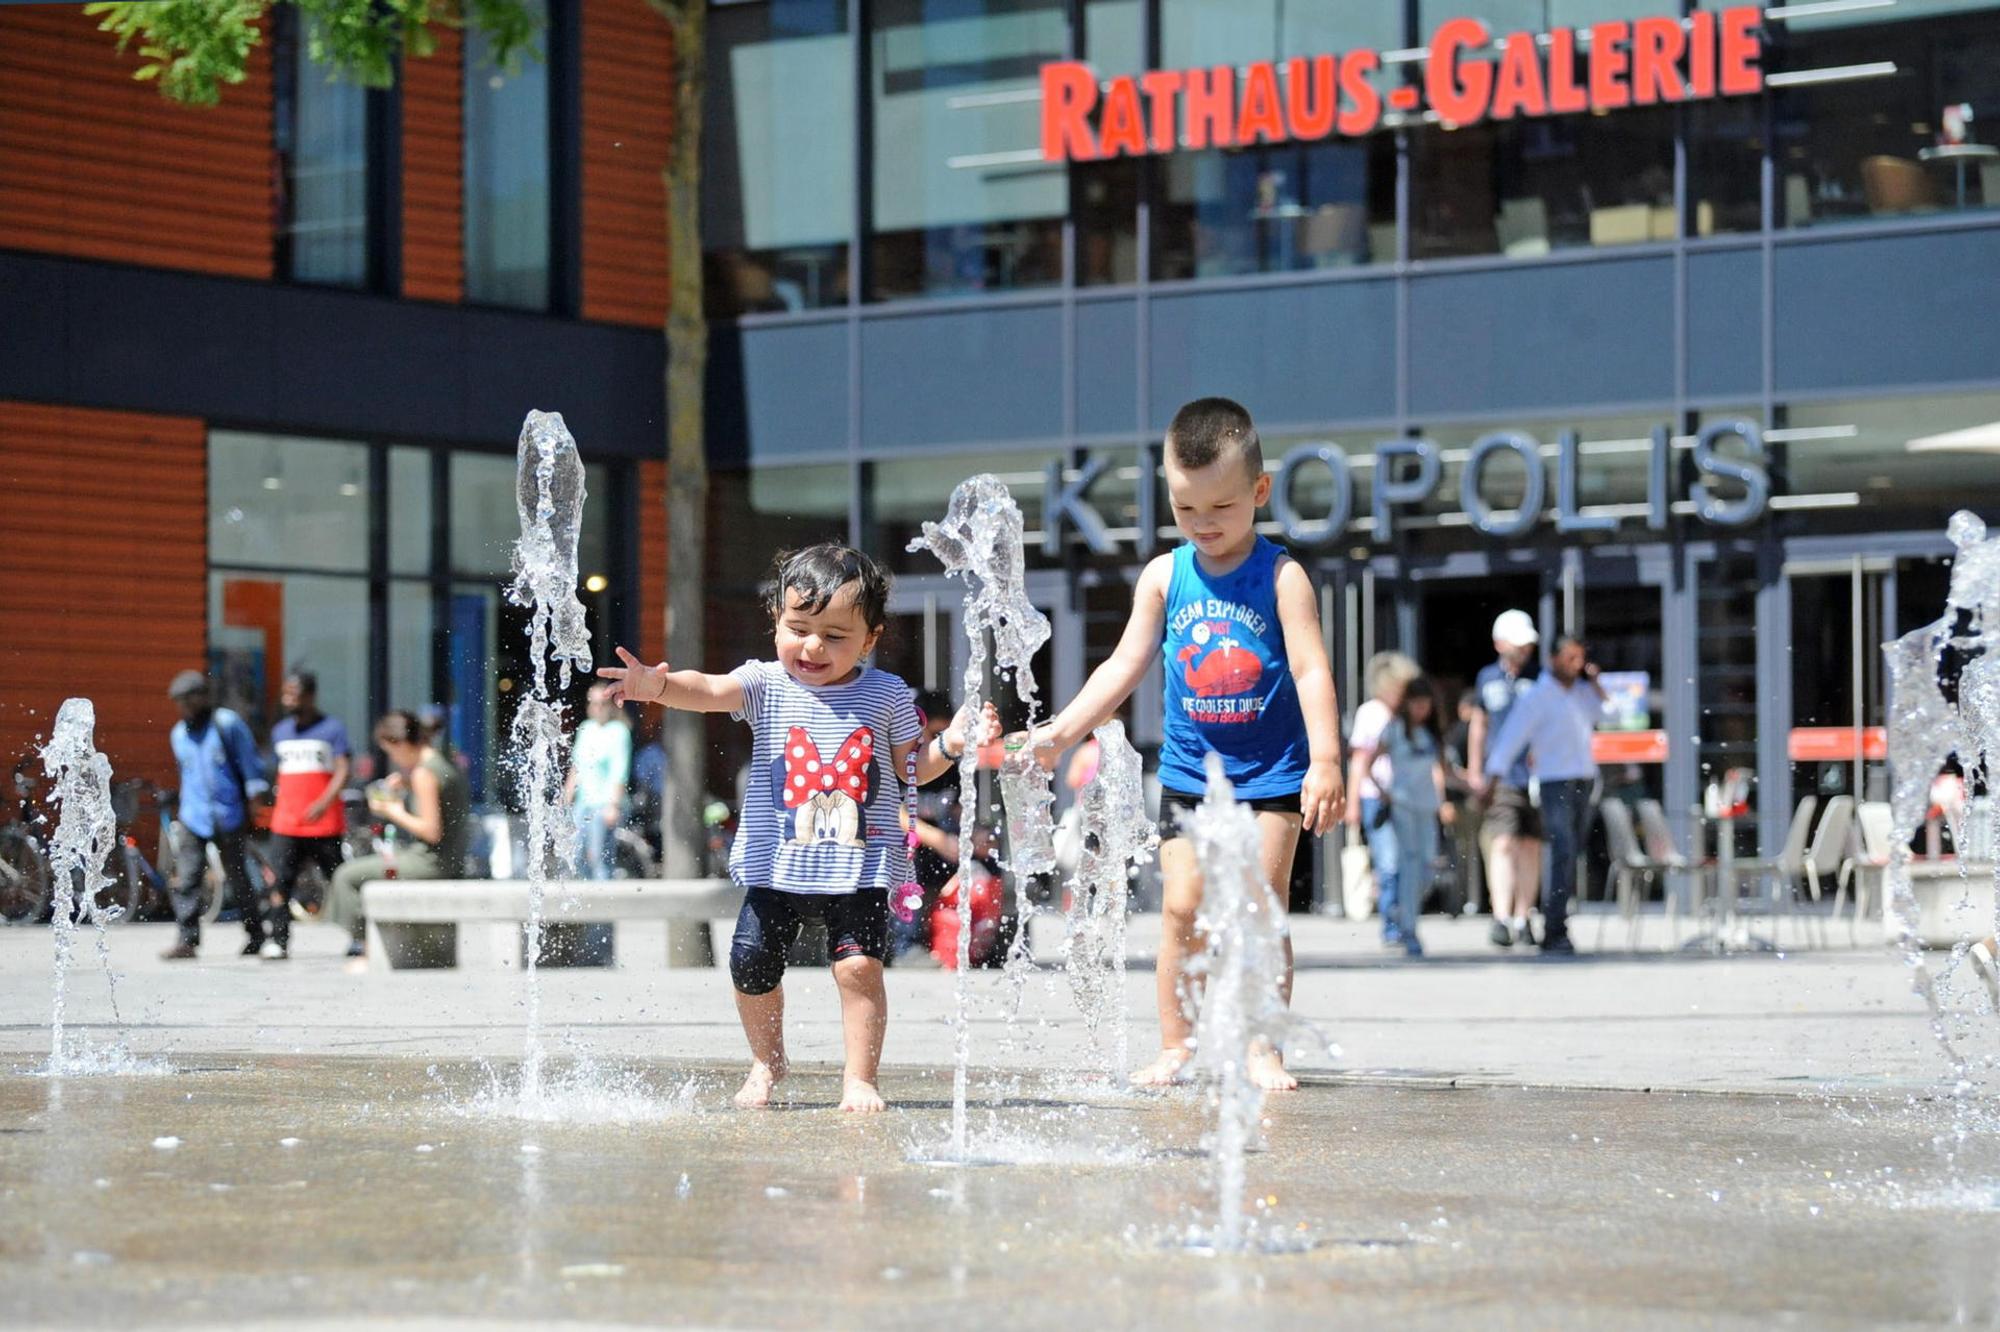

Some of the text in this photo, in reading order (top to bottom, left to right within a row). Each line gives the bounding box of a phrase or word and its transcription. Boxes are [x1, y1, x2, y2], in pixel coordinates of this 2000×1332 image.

[1041, 416, 1770, 557] KIOPOLIS
[1207, 599, 1267, 638] EXPLORER
[1195, 698, 1236, 713] COOLEST
